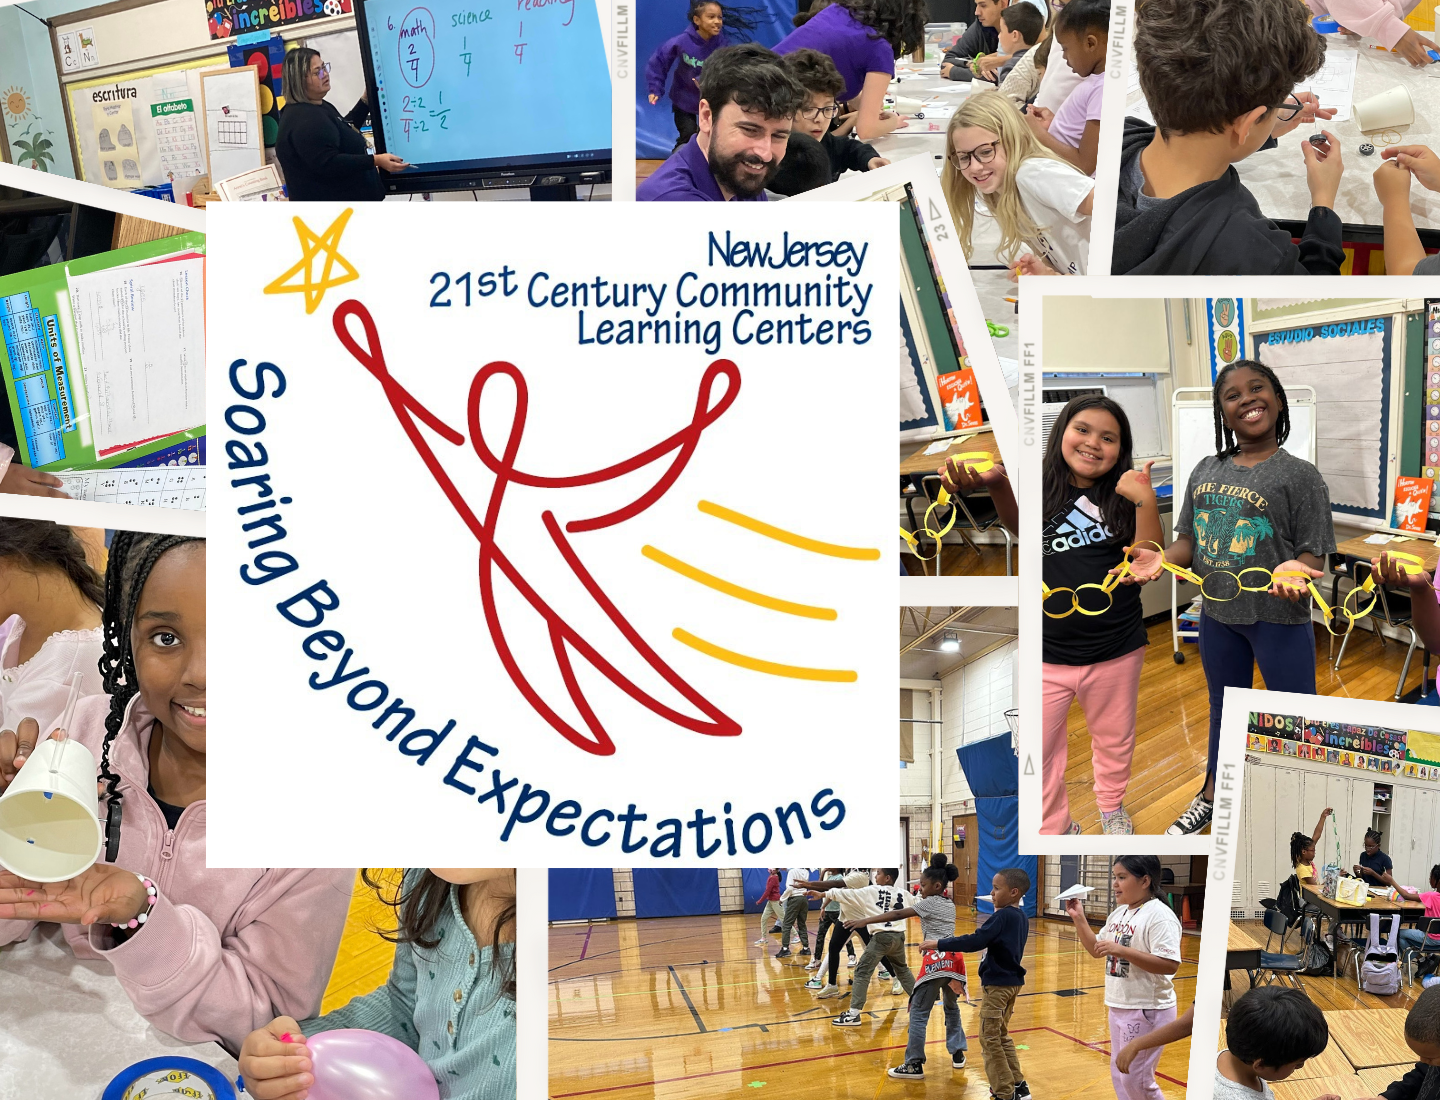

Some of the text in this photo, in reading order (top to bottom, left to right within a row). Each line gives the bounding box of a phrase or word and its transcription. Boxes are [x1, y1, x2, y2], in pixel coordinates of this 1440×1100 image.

[400, 18, 428, 40] math
[451, 9, 493, 28] science
[92, 84, 137, 102] escritura
[156, 102, 187, 113] El alfabeto
[1268, 318, 1385, 346] ESTUDIO SOCIALES
[47, 319, 72, 430] Units of Measurement
[1193, 482, 1269, 511] THE FIERCE
[1204, 494, 1244, 509] TIGERS
[1051, 522, 1114, 552] adid
